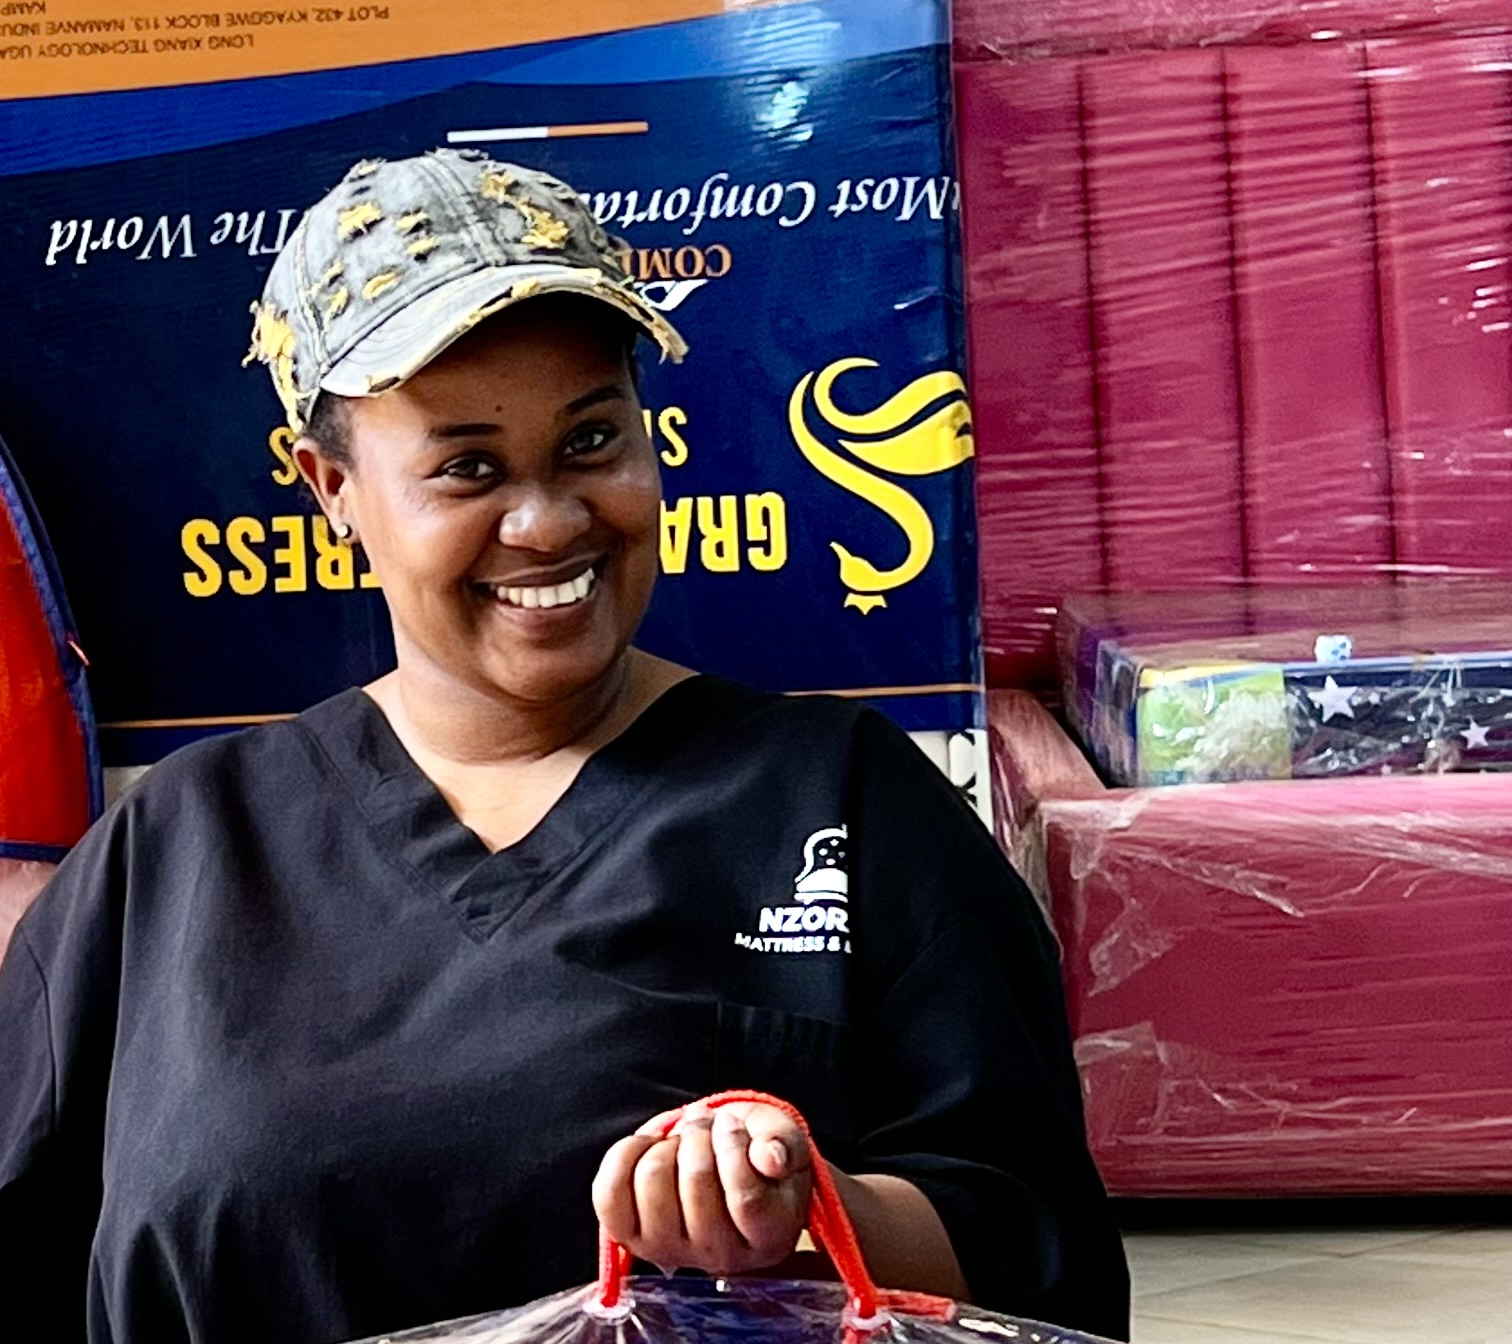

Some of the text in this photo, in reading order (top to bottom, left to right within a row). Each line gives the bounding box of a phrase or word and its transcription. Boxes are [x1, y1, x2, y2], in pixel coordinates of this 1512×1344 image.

[166, 13, 221, 28] BLOCK
[347, 5, 390, 21] PLOT
[45, 18, 126, 34] NAMANVE
[38, 40, 148, 57] TECHNOLOGY
[154, 38, 201, 53] XIANG
[208, 33, 255, 49] LONG
[580, 172, 817, 236] Comforta
[829, 176, 948, 223] Most
[45, 208, 301, 266] The World
[659, 491, 788, 574] GRA
[758, 905, 850, 934] NZOR
